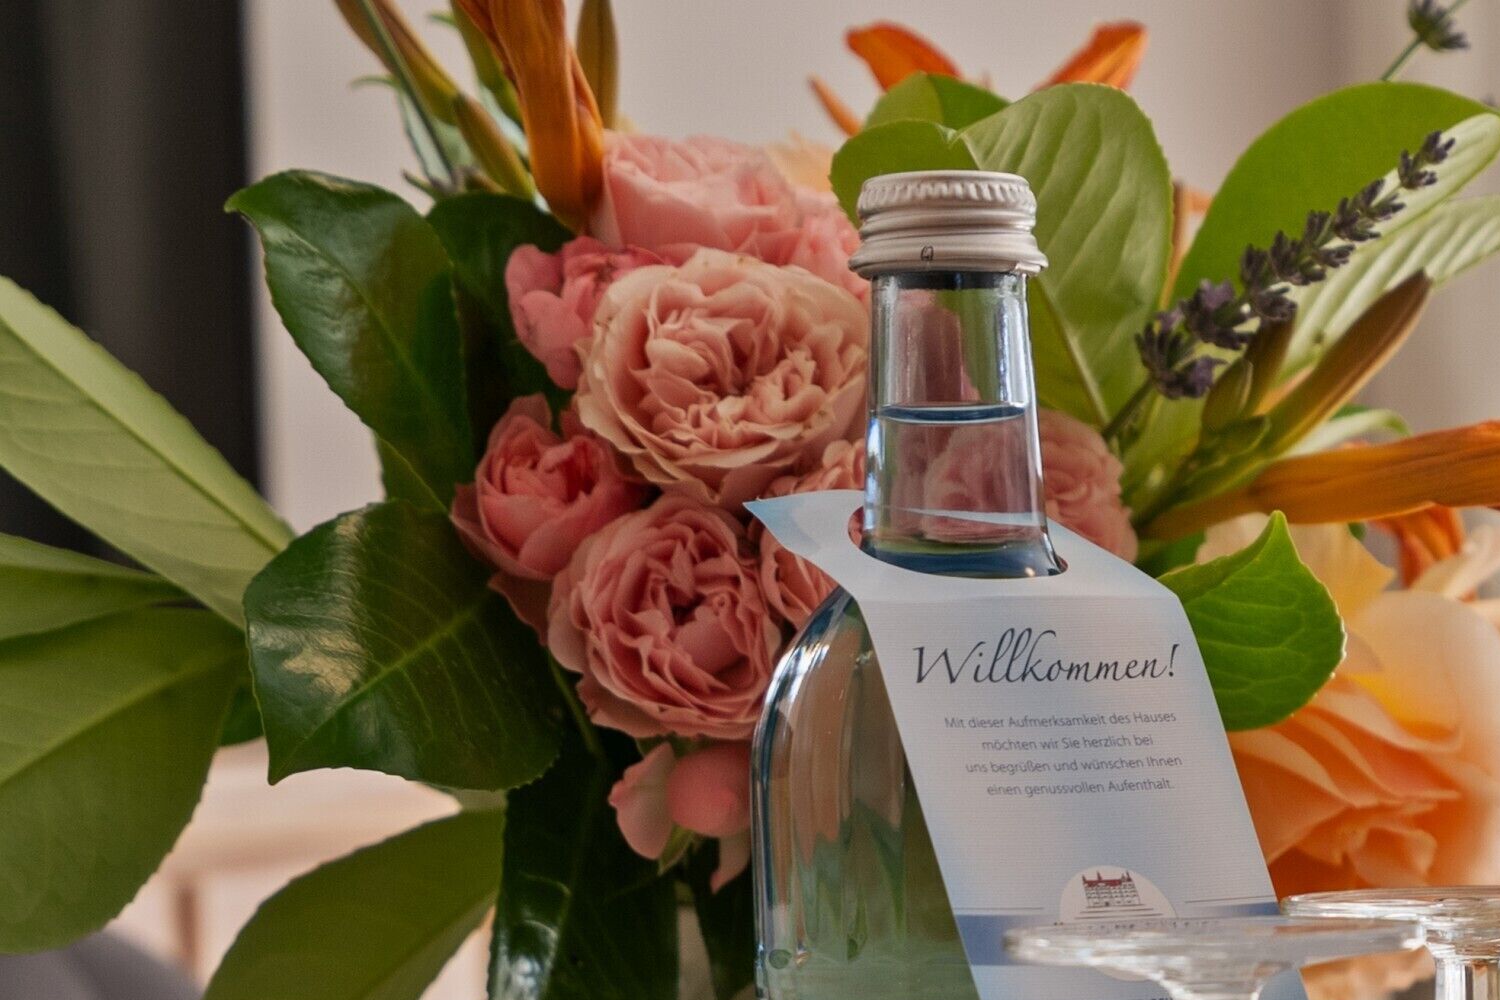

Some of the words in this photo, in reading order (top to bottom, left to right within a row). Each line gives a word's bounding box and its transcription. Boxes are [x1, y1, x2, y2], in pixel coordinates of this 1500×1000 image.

[912, 627, 1180, 684] Willkommen!
[944, 717, 964, 728] Mit
[968, 715, 1004, 728] dieser
[1009, 713, 1106, 728] Aufmerksamkeit
[1108, 712, 1131, 725] des
[1134, 711, 1177, 724] Hauses
[982, 739, 1037, 751] möchten
[1040, 738, 1059, 750] wir
[1061, 737, 1080, 749] Sie
[1083, 735, 1131, 748] herzlich
[1134, 734, 1154, 747] bei
[966, 763, 987, 774] uns
[990, 760, 1050, 776] begrüßen
[1053, 759, 1078, 772] und
[1081, 757, 1144, 771] wünschen
[1147, 755, 1182, 768] Ihnen
[987, 784, 1021, 796] einen
[1025, 782, 1104, 799] genussvollen
[1108, 779, 1175, 793] Aufenthalt.
